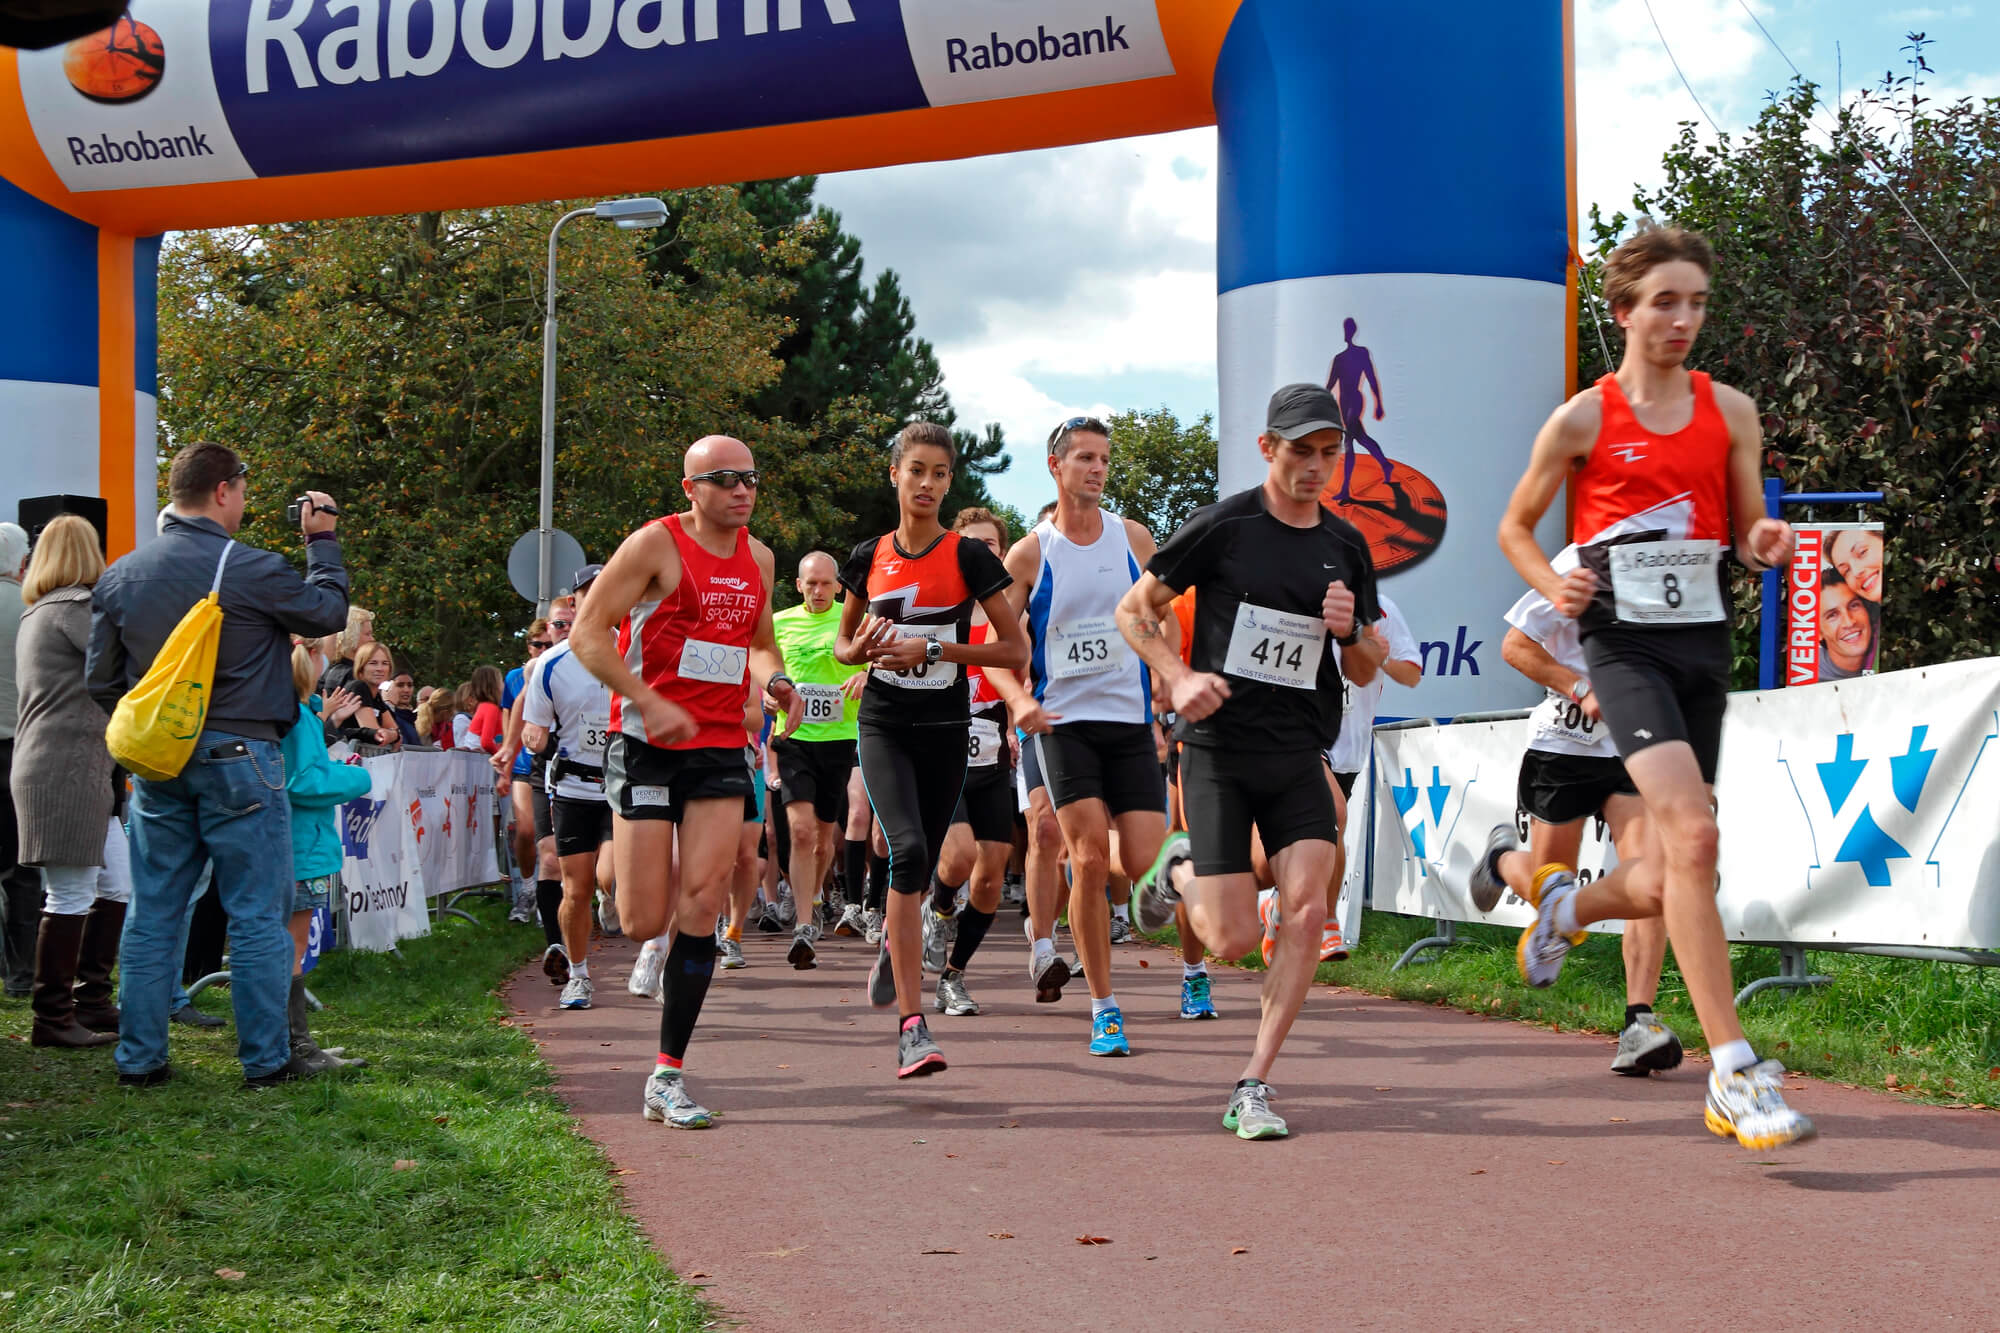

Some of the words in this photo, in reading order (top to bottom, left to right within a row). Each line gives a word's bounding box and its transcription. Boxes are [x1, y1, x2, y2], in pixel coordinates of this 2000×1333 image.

[245, 0, 856, 94] Raboba
[946, 15, 1130, 73] Rabobank
[66, 125, 215, 166] Rabobank
[1635, 549, 1712, 568] Rabobank
[701, 591, 757, 608] VEDETTE
[1663, 573, 1682, 608] 8
[706, 608, 751, 624] SPORT
[1790, 532, 1818, 684] VERKOCHT
[1067, 638, 1109, 664] 453
[1250, 637, 1304, 672] 414
[800, 687, 841, 697] Rabobank
[804, 698, 832, 718] 186
